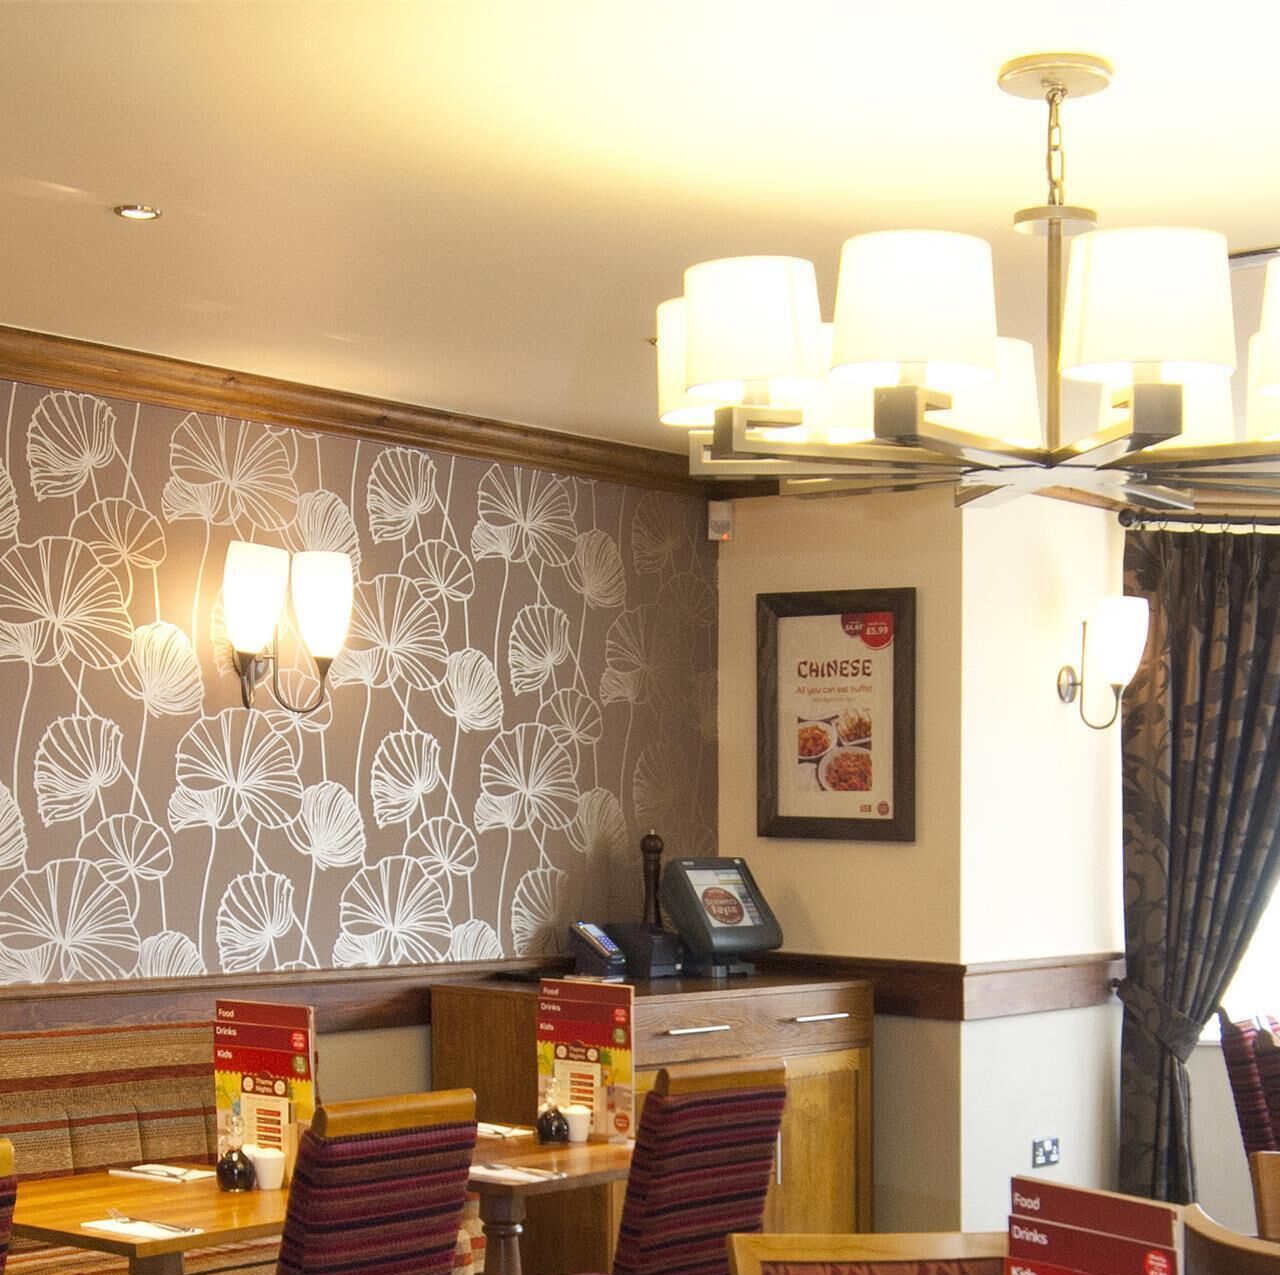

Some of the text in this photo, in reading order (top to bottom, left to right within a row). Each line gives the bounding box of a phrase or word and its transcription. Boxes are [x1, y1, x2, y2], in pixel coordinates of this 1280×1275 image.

[866, 626, 888, 635] £5.99
[798, 659, 872, 678] CHINESE
[543, 987, 559, 995] Food
[540, 1002, 561, 1011] Drinks
[218, 1009, 234, 1018] Food
[216, 1026, 237, 1036] Drinks
[217, 1050, 233, 1059] Kids
[1014, 1192, 1041, 1211] Food
[1011, 1225, 1049, 1246] Drinks
